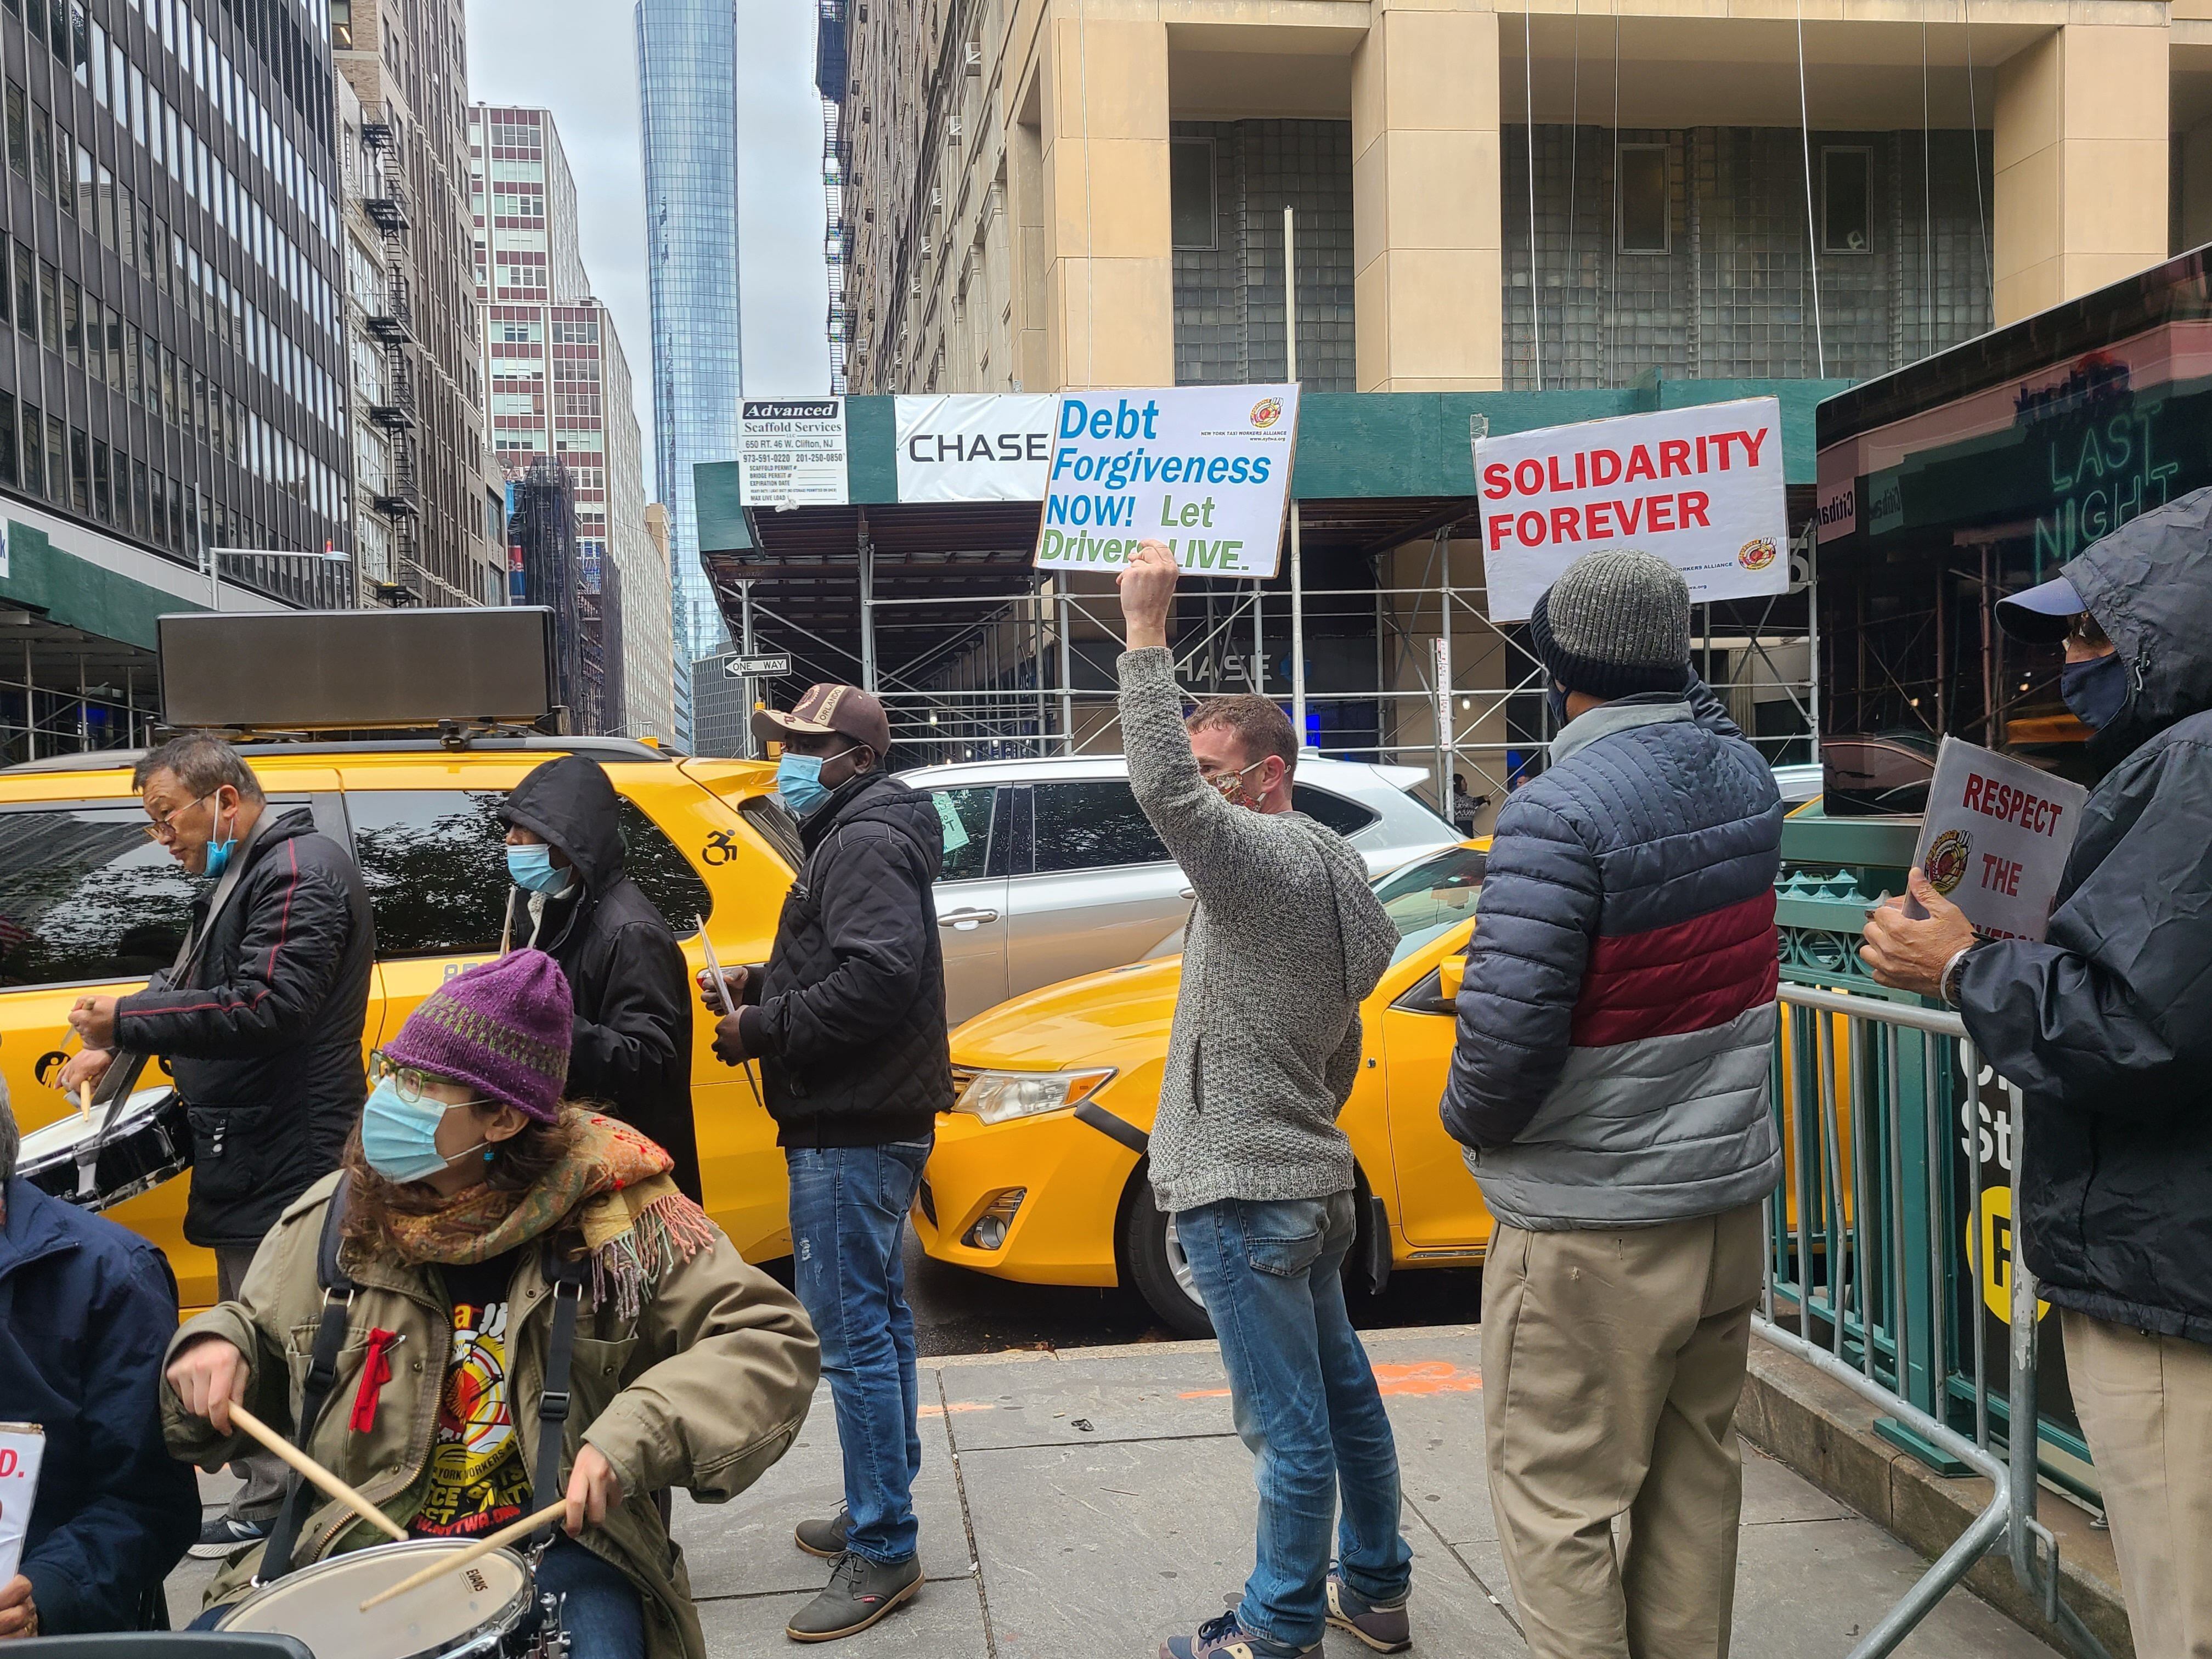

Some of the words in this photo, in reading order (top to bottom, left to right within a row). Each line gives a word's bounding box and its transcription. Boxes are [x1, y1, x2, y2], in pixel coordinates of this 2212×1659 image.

[744, 422, 791, 432] Scaffold
[795, 421, 842, 432] Services
[745, 404, 834, 417] Advanced
[1059, 399, 1159, 439] Debt
[743, 454, 791, 462] 973-591-0220
[795, 453, 843, 462] 201-250-0850
[746, 440, 759, 448] 650
[760, 440, 772, 448] RT.
[774, 440, 783, 448] 46
[784, 439, 793, 448] W.
[795, 439, 822, 449] Clifton,
[823, 439, 833, 448] NJ
[909, 433, 1050, 462] CHASE
[2052, 401, 2163, 493] LAST
[1052, 448, 1271, 490] Forgiveness
[1483, 428, 1768, 500] SOLIDARITY
[1046, 495, 1136, 527] NOW!
[1161, 495, 1215, 527] Let
[1488, 491, 1711, 551] FOREVER
[2035, 462, 2179, 586] NIGHT
[733, 662, 752, 671] ONE
[763, 660, 785, 670] WAY
[1173, 654, 1272, 682] HASE
[820, 689, 841, 721] ORLANDO
[1963, 773, 2063, 838] RESPECT
[1982, 853, 2023, 897] THE
[439, 1468, 462, 1481] YORK
[466, 1568, 488, 1592] EVANS
